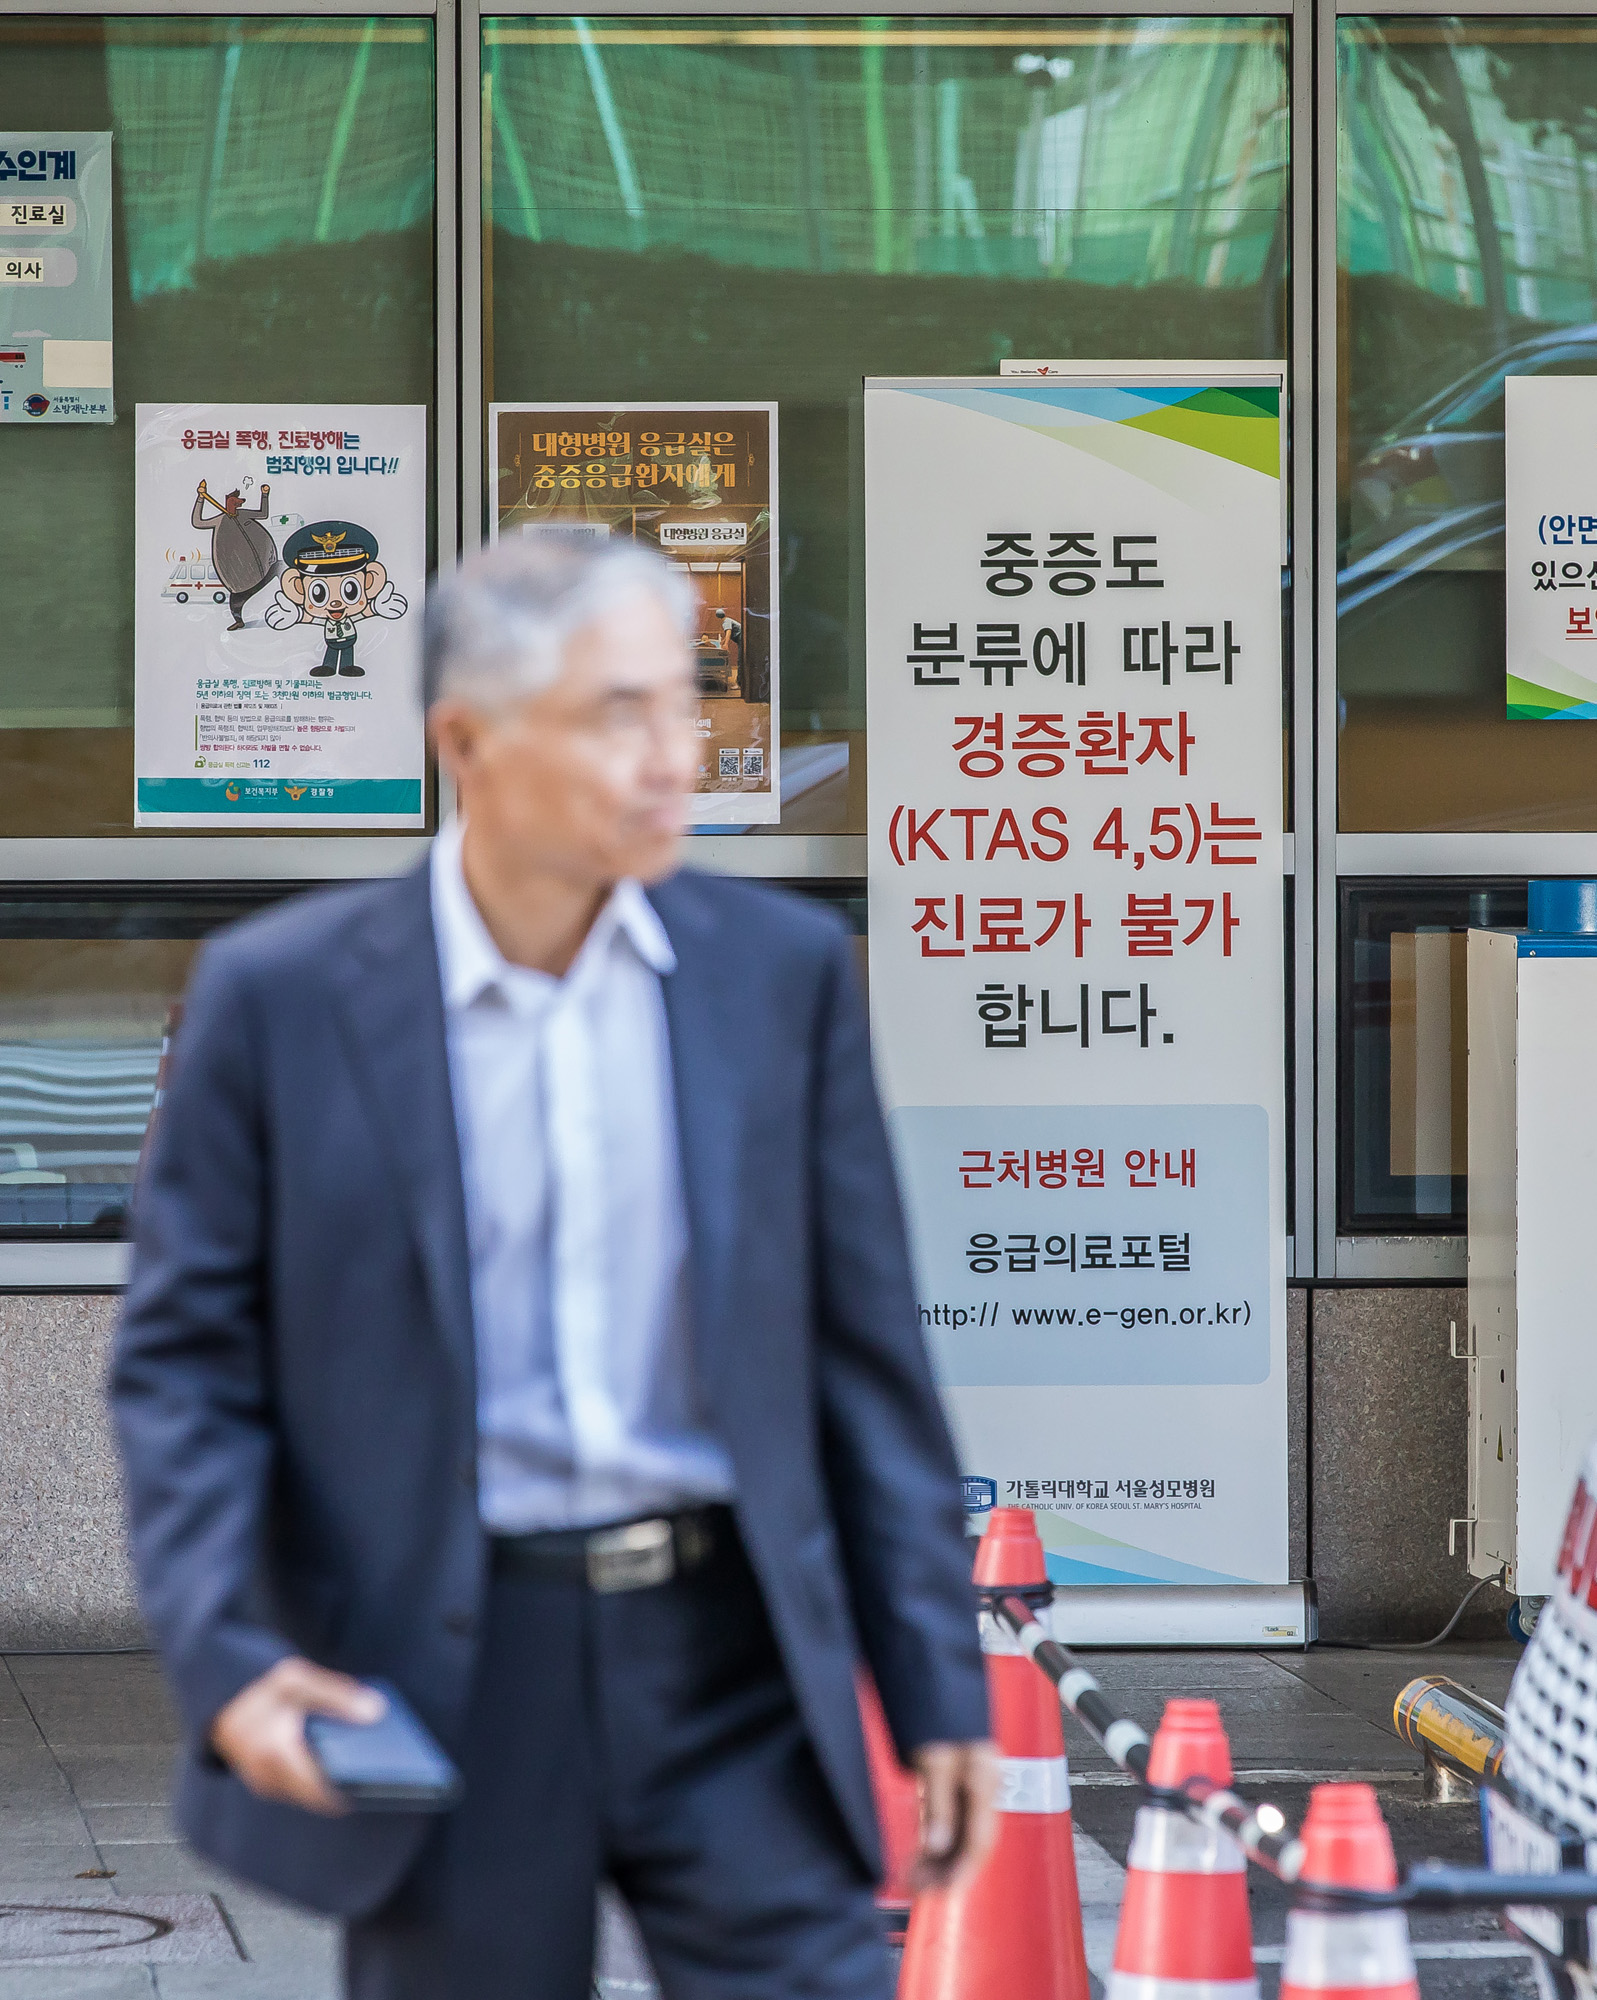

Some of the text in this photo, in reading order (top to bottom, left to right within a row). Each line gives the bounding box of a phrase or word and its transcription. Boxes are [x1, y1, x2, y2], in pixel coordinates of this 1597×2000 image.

[11, 205, 64, 225] 진료실
[5, 262, 42, 279] 의사
[52, 404, 107, 414] 소방재난본부
[181, 429, 360, 450] 응급실 폭행, 진료방해는
[532, 431, 736, 457] 대형병원 응급실은
[266, 456, 399, 475] 범죄행위 입니다!!
[532, 463, 736, 488] 중증응급환자에게
[663, 528, 745, 541] 대형병원 응급실
[980, 533, 1165, 596] 중증도
[1566, 607, 1597, 634] 보
[907, 621, 1241, 686] 분류에 따라
[196, 679, 219, 689] 응급실
[242, 679, 272, 689] 진료방해
[275, 679, 282, 689] 및
[285, 679, 323, 689] 기물파괴는
[196, 690, 209, 700] 5년
[211, 690, 234, 699] 이하의
[236, 690, 251, 700] 징역
[254, 690, 269, 700] 또는
[272, 690, 299, 700] 3천만원
[302, 690, 324, 699] 이하의
[952, 710, 1195, 778] 경증환자
[253, 759, 271, 769] 112
[244, 787, 334, 797] 보건복지부 경찰청
[888, 802, 1262, 871] (KTAS 4,5)는
[911, 892, 1240, 958] 진료가 불가
[976, 983, 1175, 1048] 합니다.
[958, 1148, 1197, 1189] 근처병원 안내
[965, 1232, 1191, 1274] 응급의료포털
[917, 1300, 1253, 1331] http:// www.e-gen.or.kr)
[1006, 1479, 1215, 1499] 가톨릭대학교 서울성모병원
[1021, 1502, 1054, 1510] CATHOLIC
[1055, 1502, 1074, 1510] UNIV.
[1075, 1502, 1084, 1510] OF
[1086, 1502, 1109, 1510] KOREA
[1110, 1502, 1131, 1510] SEOUL
[1132, 1502, 1141, 1510] ST.
[1143, 1502, 1169, 1510] MARY'S
[1170, 1502, 1202, 1510] HOSPITAL
